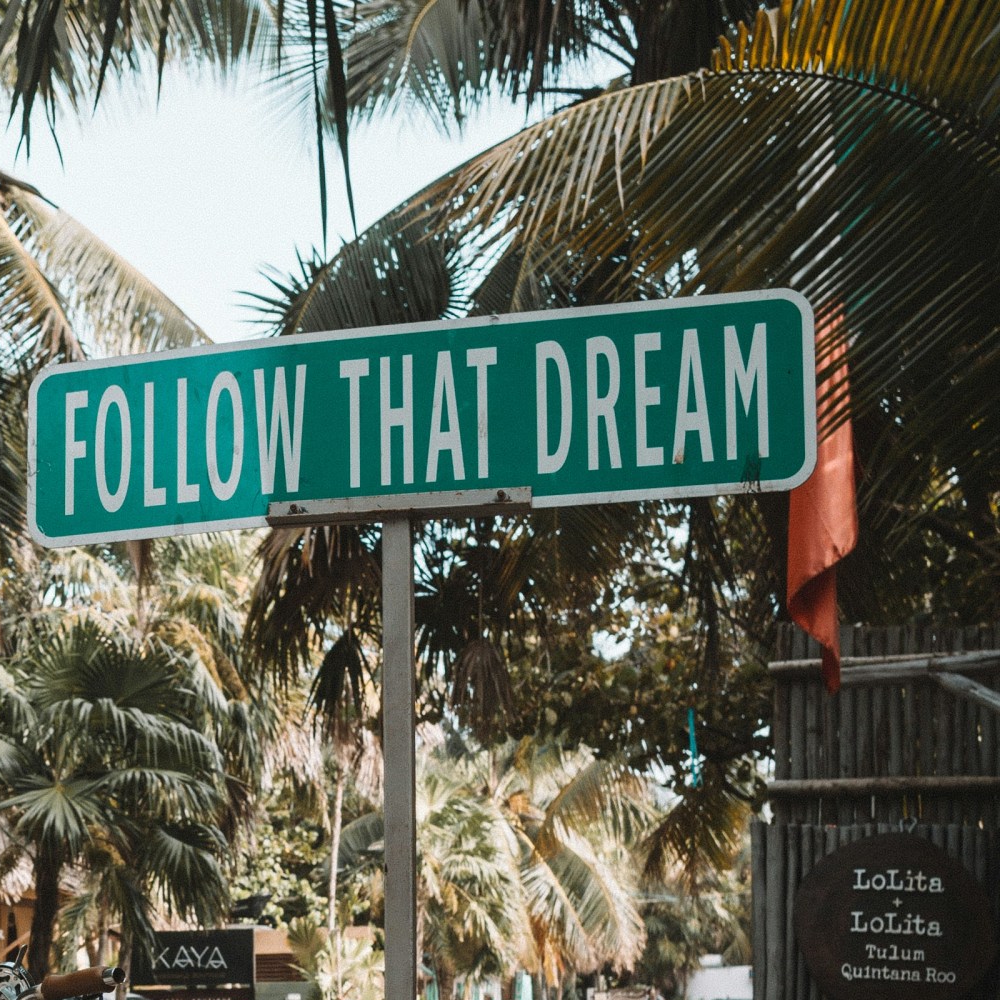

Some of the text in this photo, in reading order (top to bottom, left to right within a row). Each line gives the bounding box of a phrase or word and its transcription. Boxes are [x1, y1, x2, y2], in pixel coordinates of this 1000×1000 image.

[64, 322, 771, 516] FOLLOW THAT DREAM
[852, 868, 945, 893] LoLita
[850, 911, 944, 937] LoLita
[151, 945, 229, 970] KAYA
[865, 944, 926, 962] Tulum
[841, 963, 957, 984] Quintana Roo
